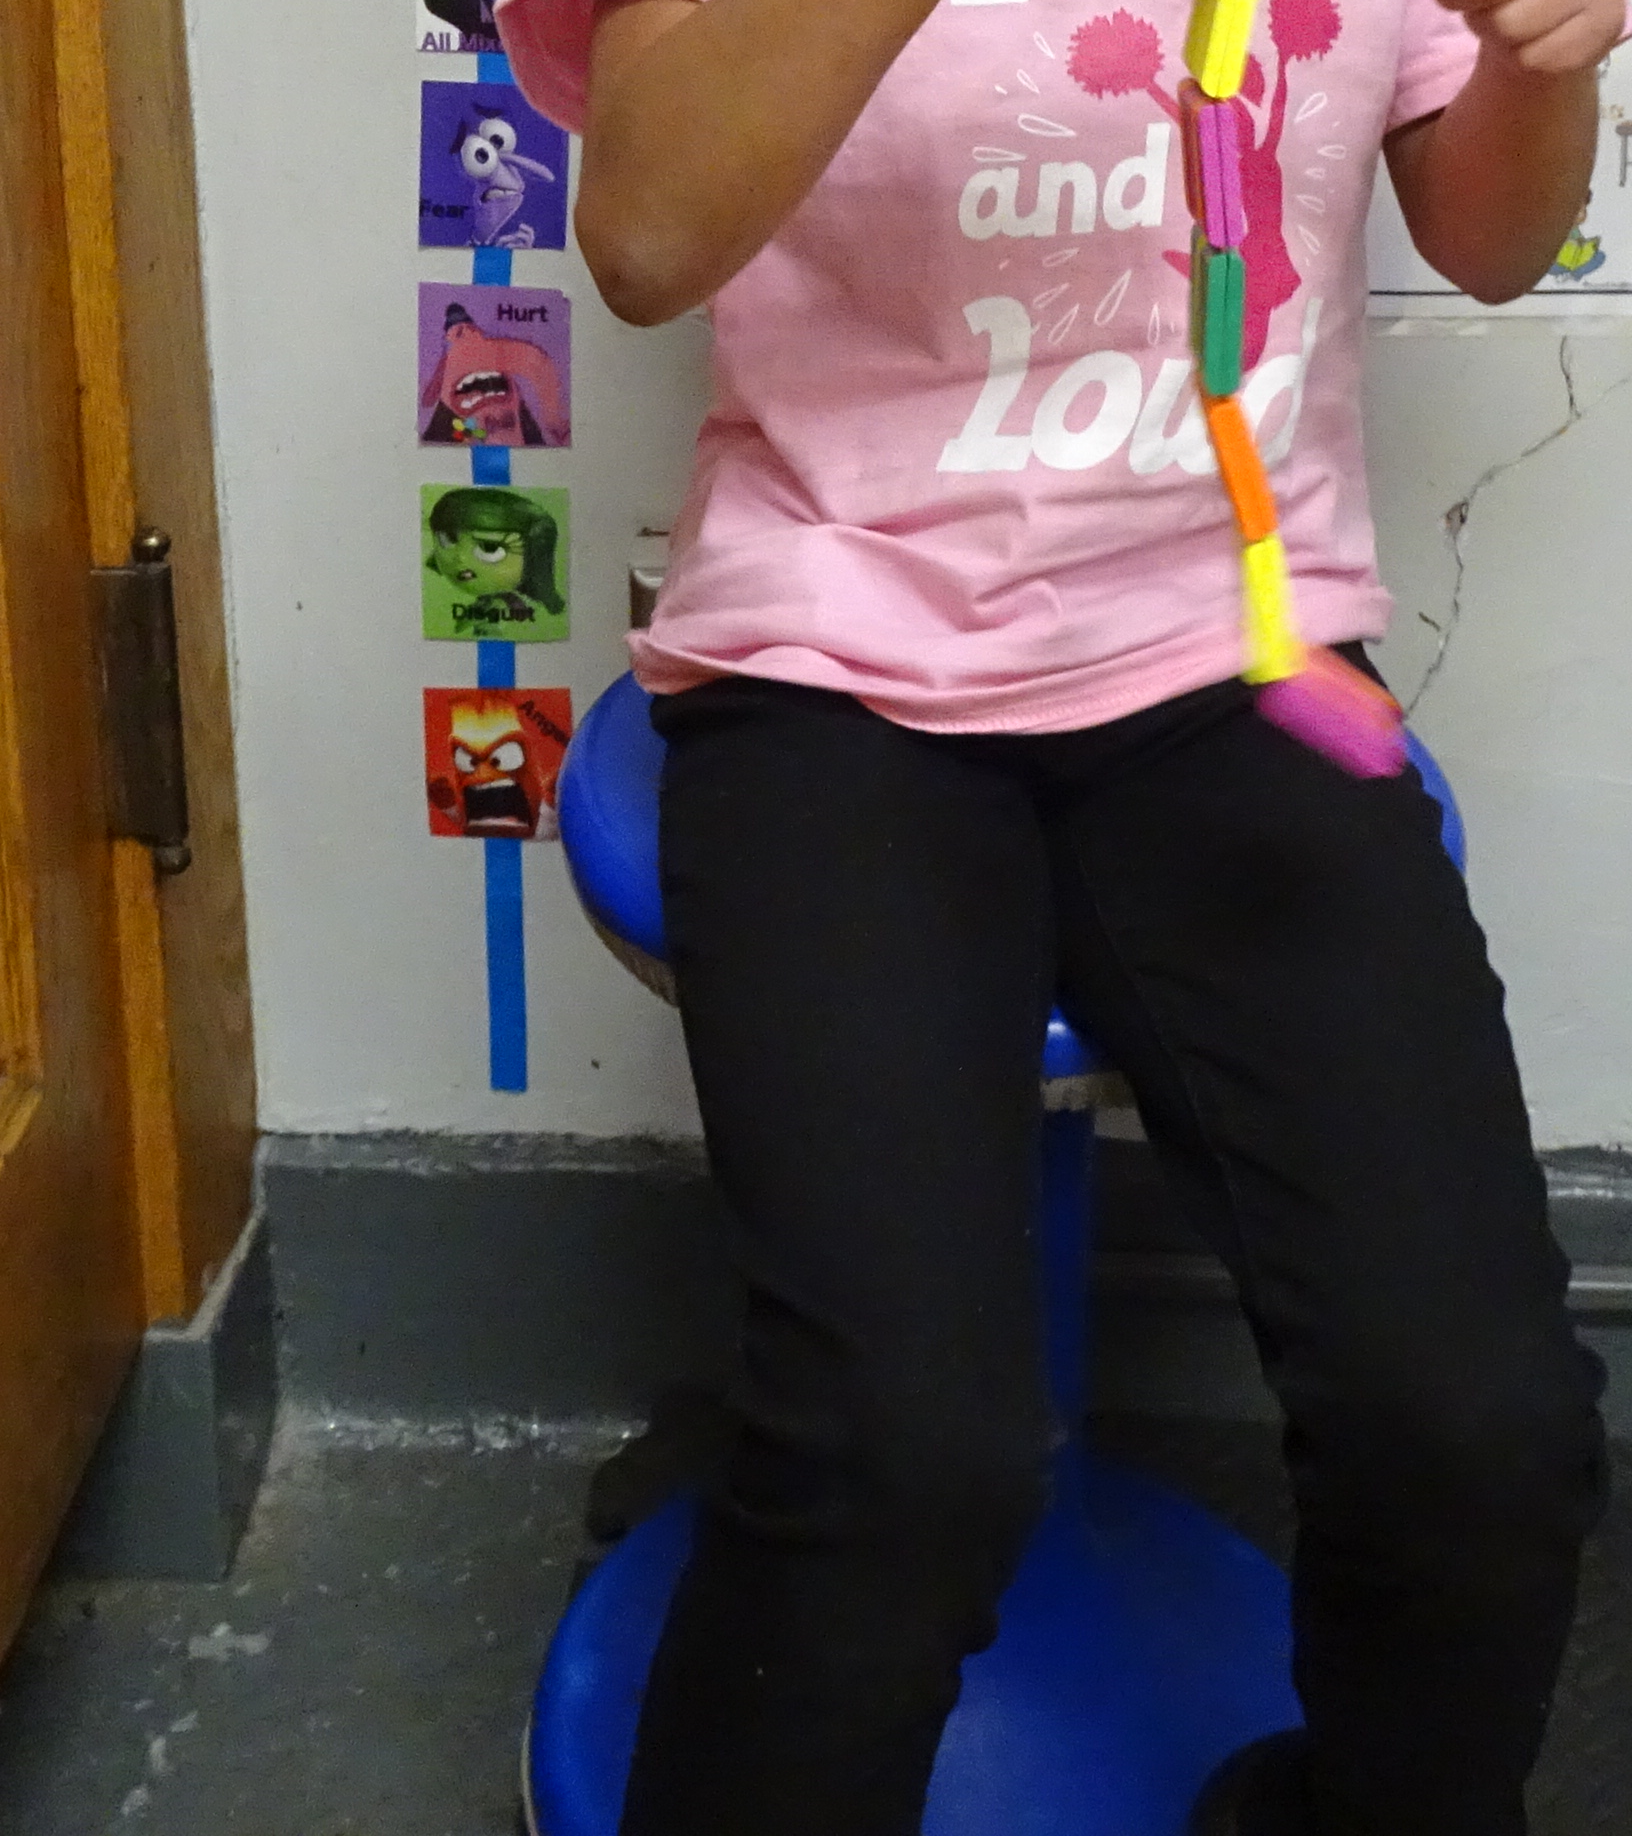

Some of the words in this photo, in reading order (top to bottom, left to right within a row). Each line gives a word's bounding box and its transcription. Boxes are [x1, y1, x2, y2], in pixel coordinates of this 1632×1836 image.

[421, 32, 450, 52] All
[958, 121, 1171, 241] and
[497, 303, 549, 324] Hurt
